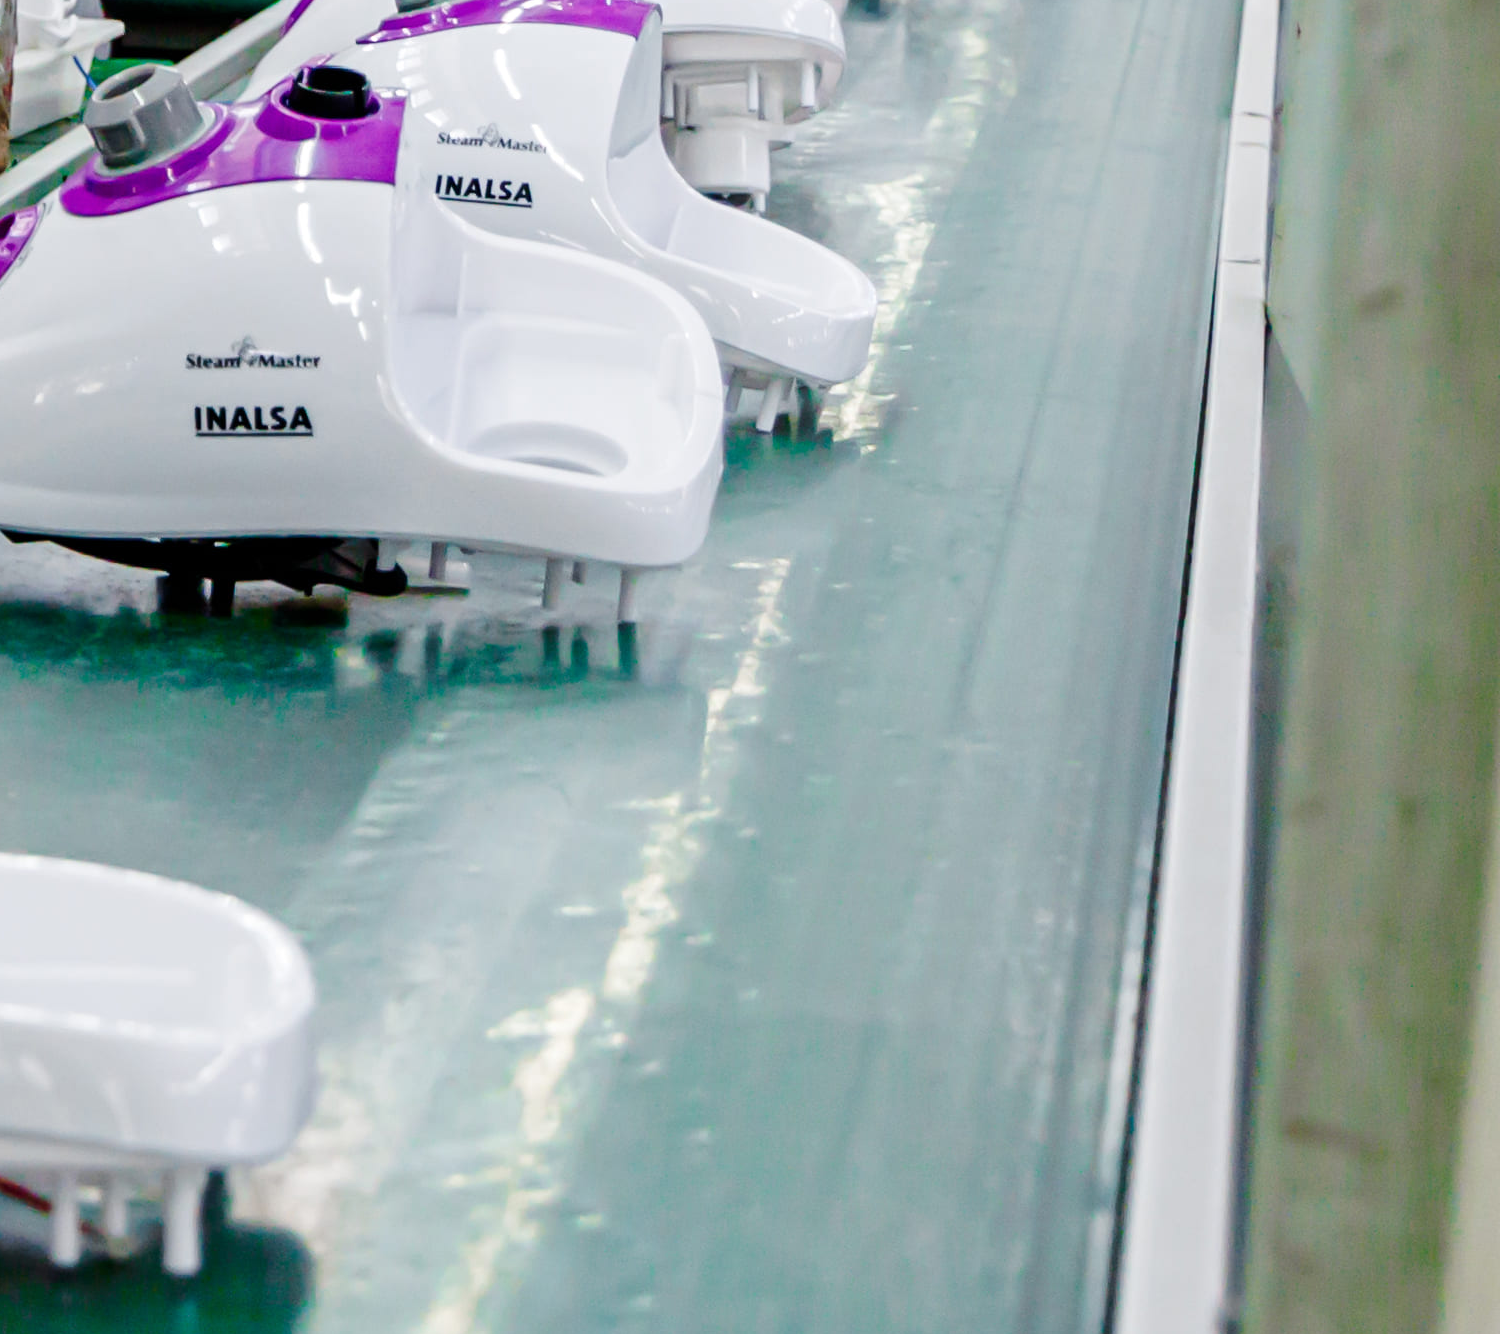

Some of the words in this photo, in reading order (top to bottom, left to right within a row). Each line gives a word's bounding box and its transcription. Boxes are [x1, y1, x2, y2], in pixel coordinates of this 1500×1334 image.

[437, 131, 484, 147] Steam
[435, 174, 533, 205] INALSA
[186, 353, 241, 369] Steam
[258, 354, 321, 368] Master
[194, 406, 313, 432] INALSA
